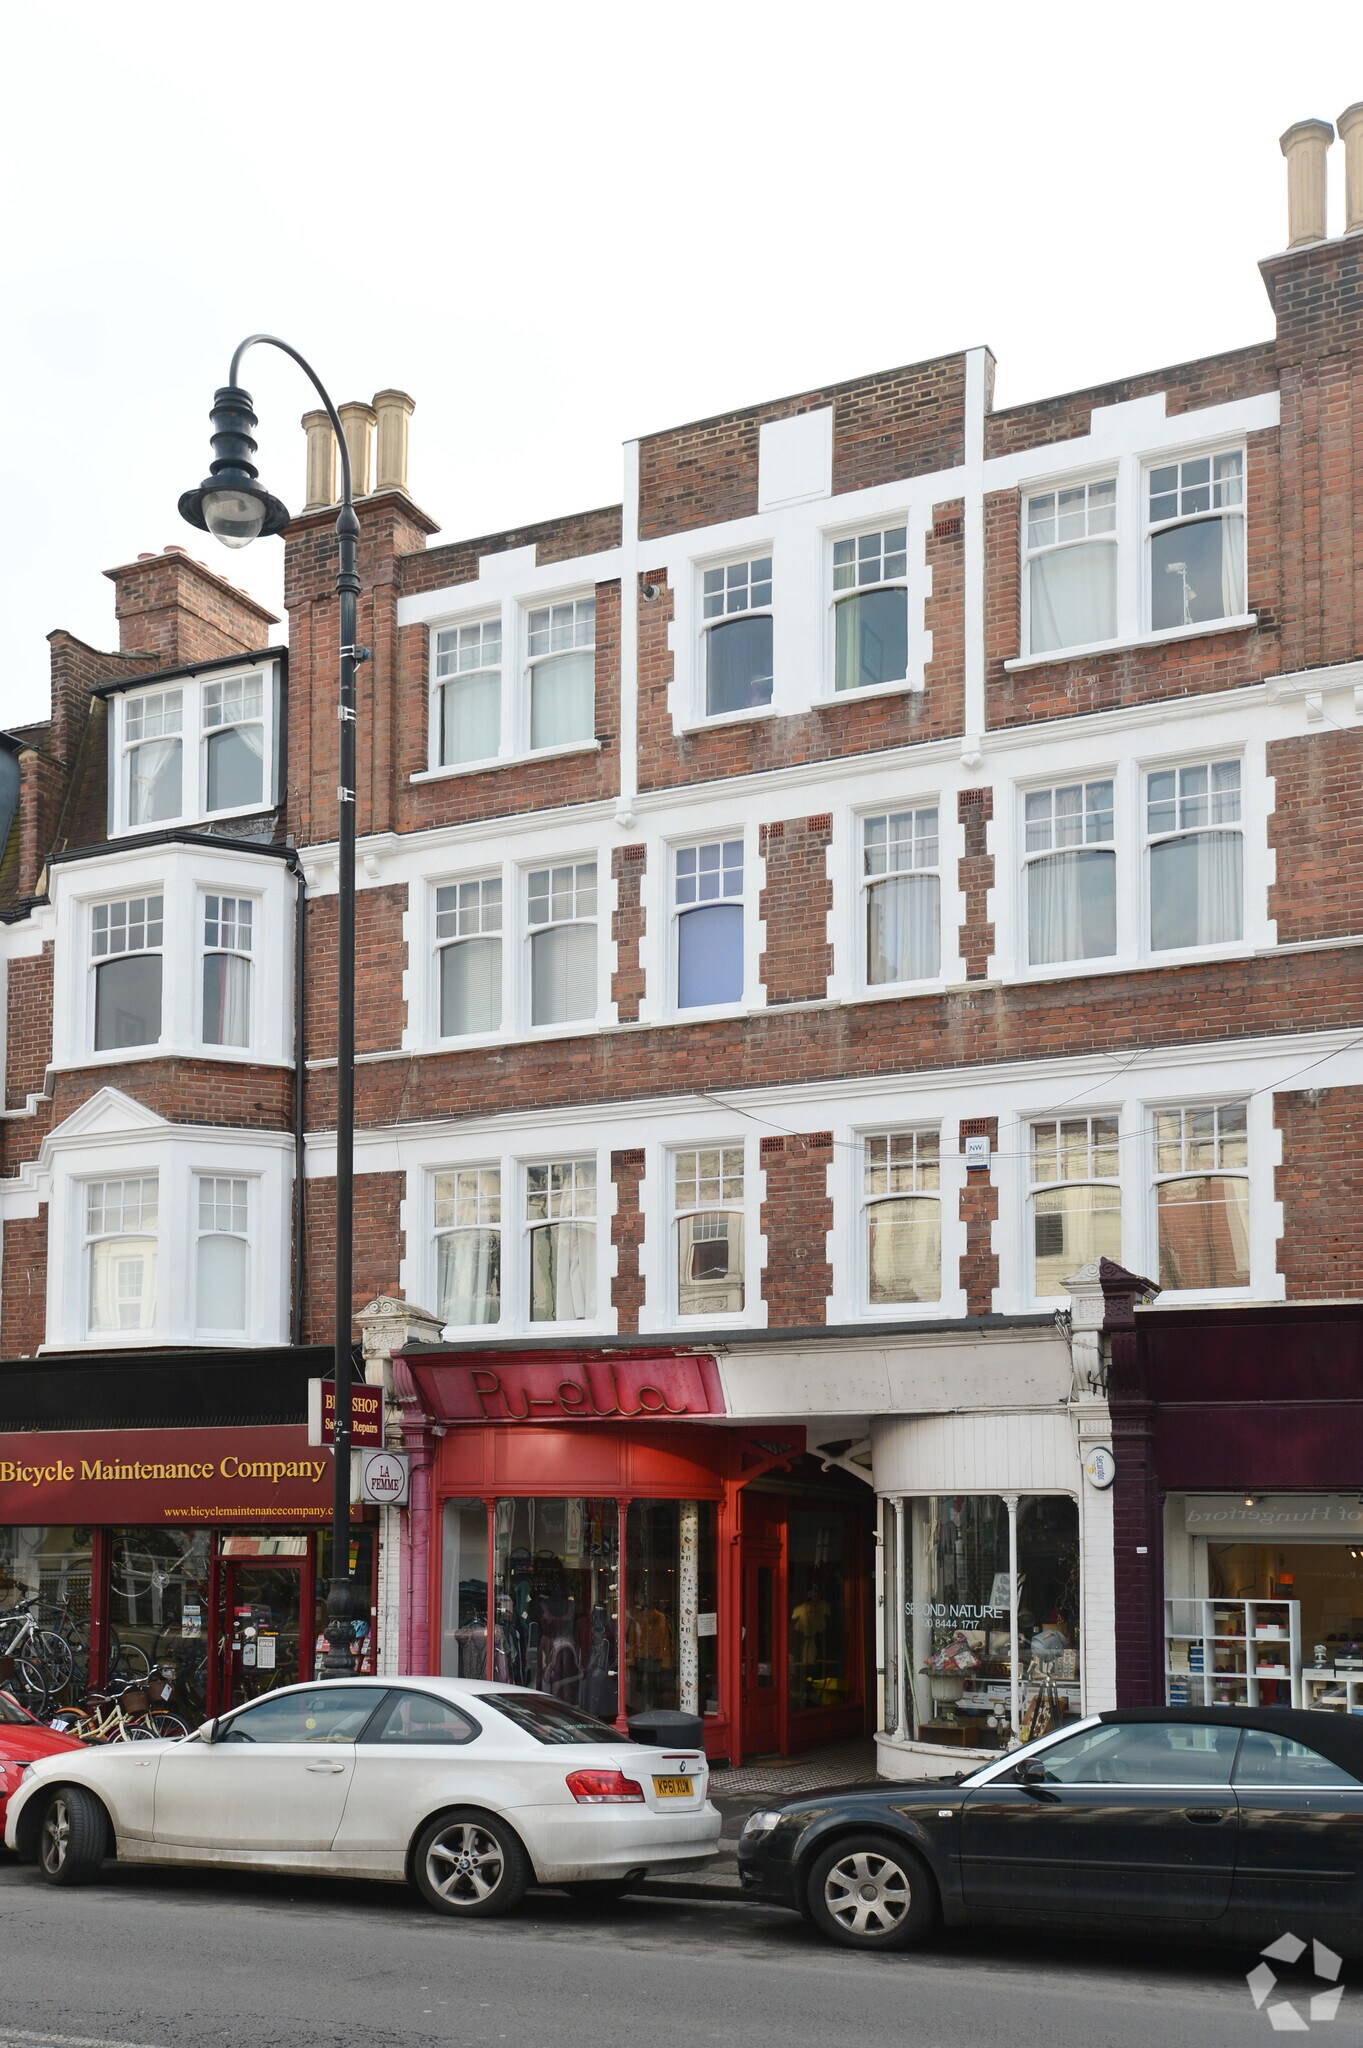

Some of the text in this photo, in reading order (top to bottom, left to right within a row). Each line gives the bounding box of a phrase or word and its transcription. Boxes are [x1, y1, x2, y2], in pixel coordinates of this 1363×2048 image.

[352, 1397, 378, 1413] SHOP
[352, 1421, 378, 1435] Repairs
[0, 1456, 327, 1487] Bicycle Maintenance Company
[379, 1465, 390, 1477] LA
[164, 1505, 355, 1519] www.bicyclemaintenancecompany.ck
[905, 1602, 1004, 1619] SEOND NATURE
[935, 1619, 957, 1628] 8444
[961, 1620, 980, 1630] 1717
[657, 1779, 676, 1794] KP61
